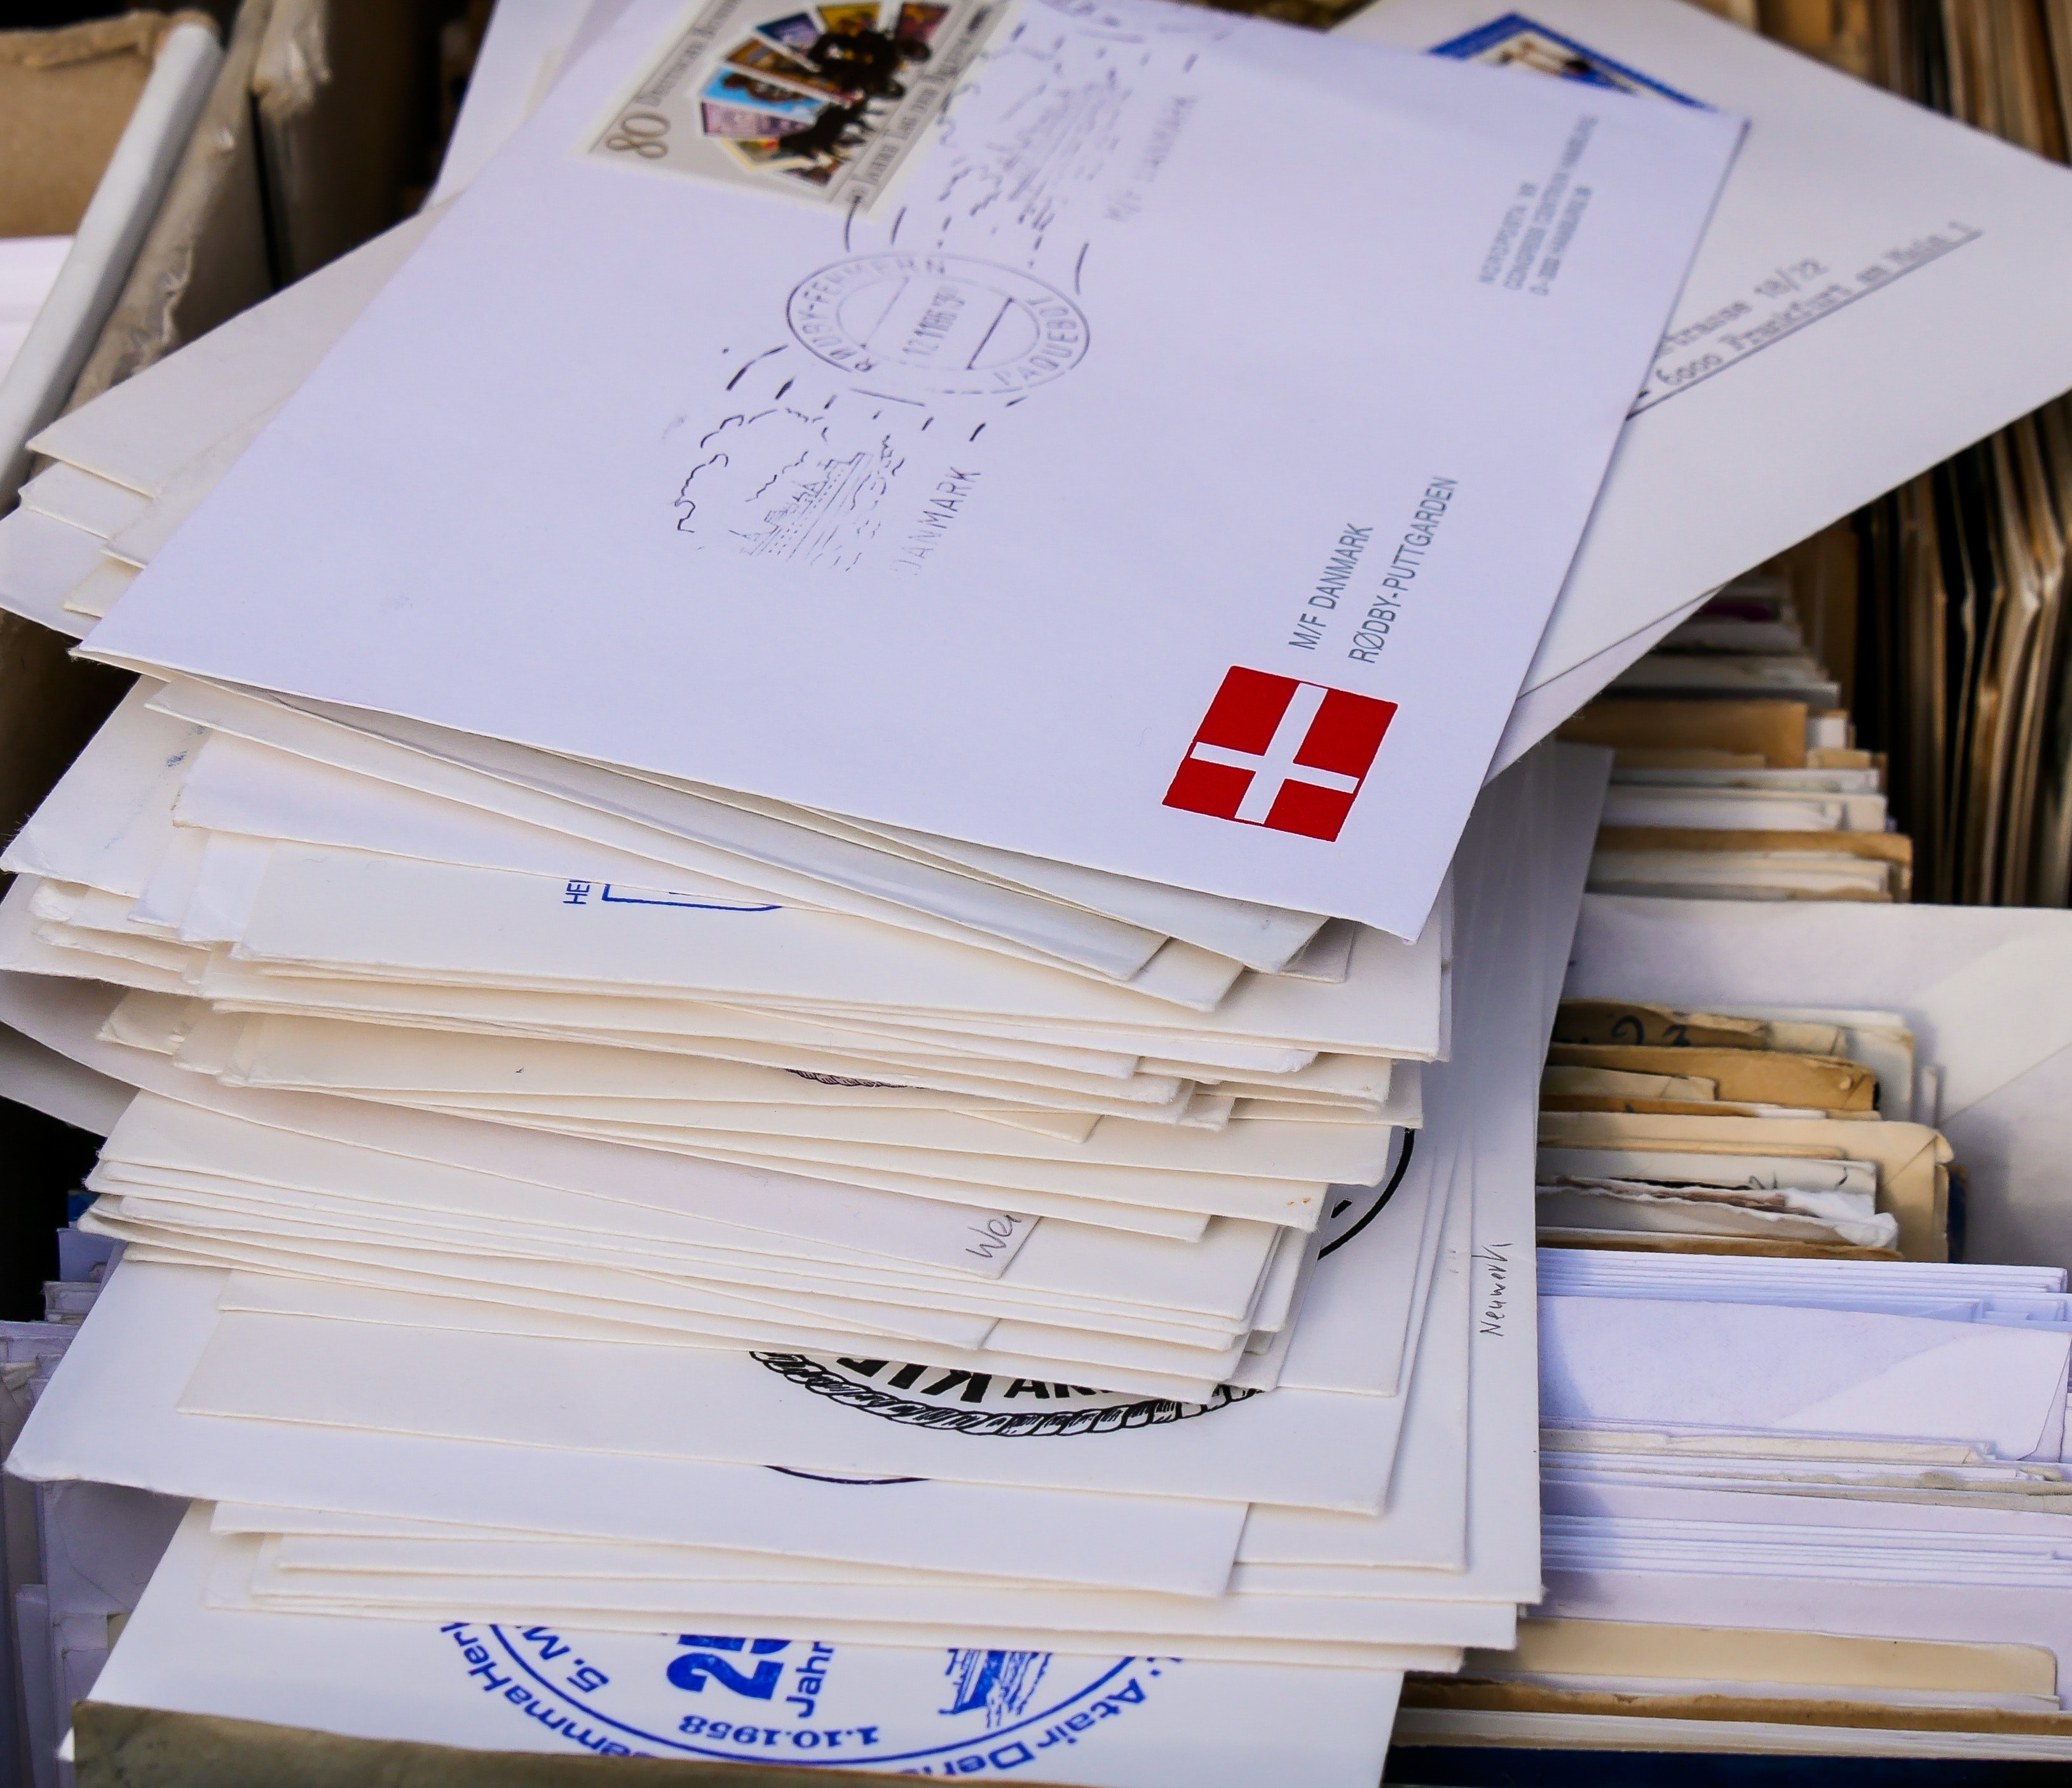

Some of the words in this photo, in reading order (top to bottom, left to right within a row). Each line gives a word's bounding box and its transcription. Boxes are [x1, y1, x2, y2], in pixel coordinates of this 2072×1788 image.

[606, 111, 671, 158] 80
[1307, 522, 1374, 611] DANMARK
[1347, 475, 1459, 664] RØDBY-PUTTGARDEN
[1288, 613, 1327, 650] M/F
[678, 1714, 880, 1749] 1.10.1958
[1037, 1677, 1146, 1746] Atair
